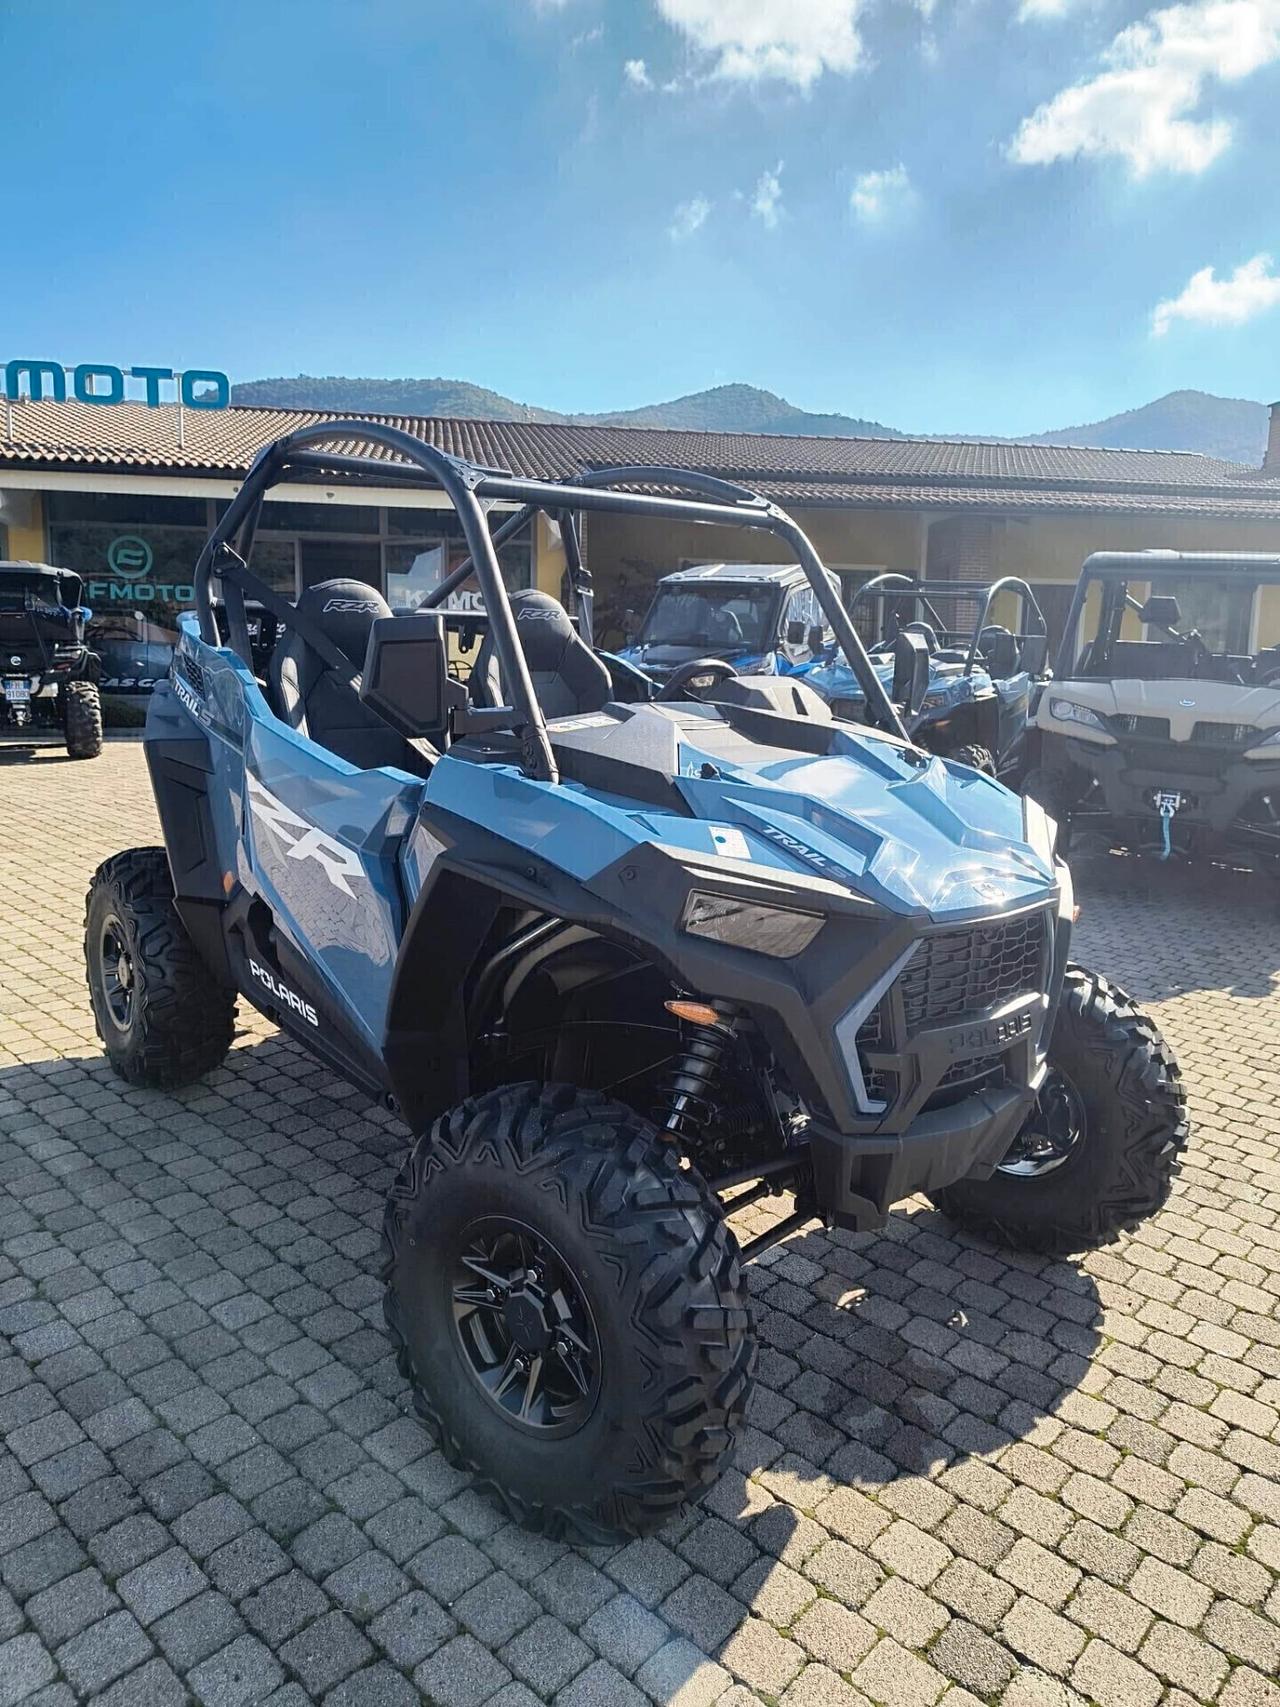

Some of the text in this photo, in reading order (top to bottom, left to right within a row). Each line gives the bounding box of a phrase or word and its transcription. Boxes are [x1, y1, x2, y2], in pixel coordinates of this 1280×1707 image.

[6, 360, 229, 410] MOTO
[89, 582, 195, 602] FMOTO
[322, 599, 379, 613] RZR
[405, 590, 486, 611] KMC
[518, 608, 561, 622] RZR
[173, 679, 199, 716] TRAIL
[763, 824, 826, 867] TRAIL
[248, 958, 319, 1027] POLARIS
